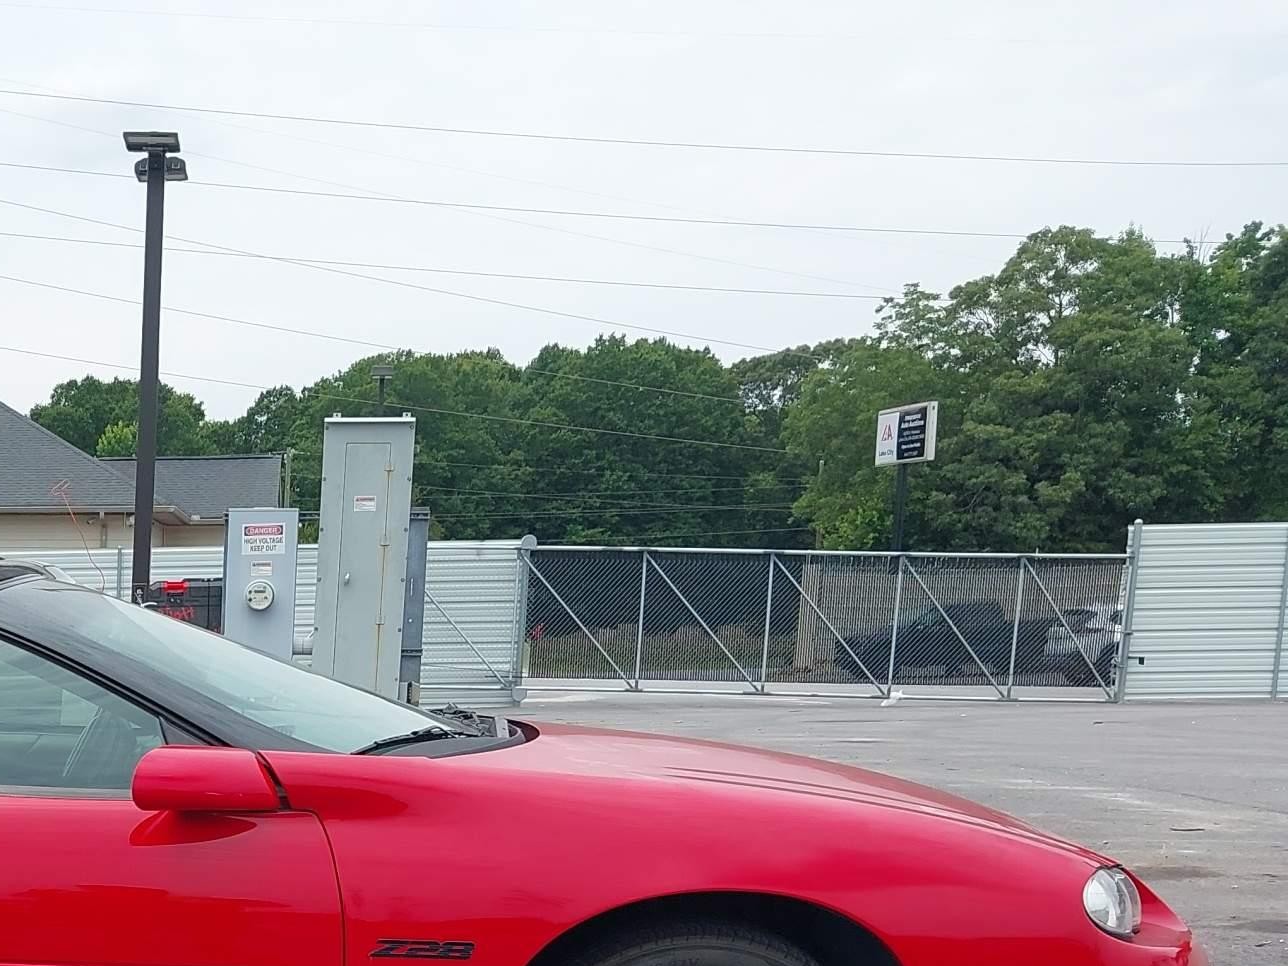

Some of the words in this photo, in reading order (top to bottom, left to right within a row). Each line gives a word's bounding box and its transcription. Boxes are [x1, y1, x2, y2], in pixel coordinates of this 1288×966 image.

[249, 527, 278, 535] DANGER
[243, 537, 258, 545] HIGH
[259, 536, 284, 544] VOLTAGE
[265, 544, 277, 552] OUT
[368, 939, 476, 960] Z28
